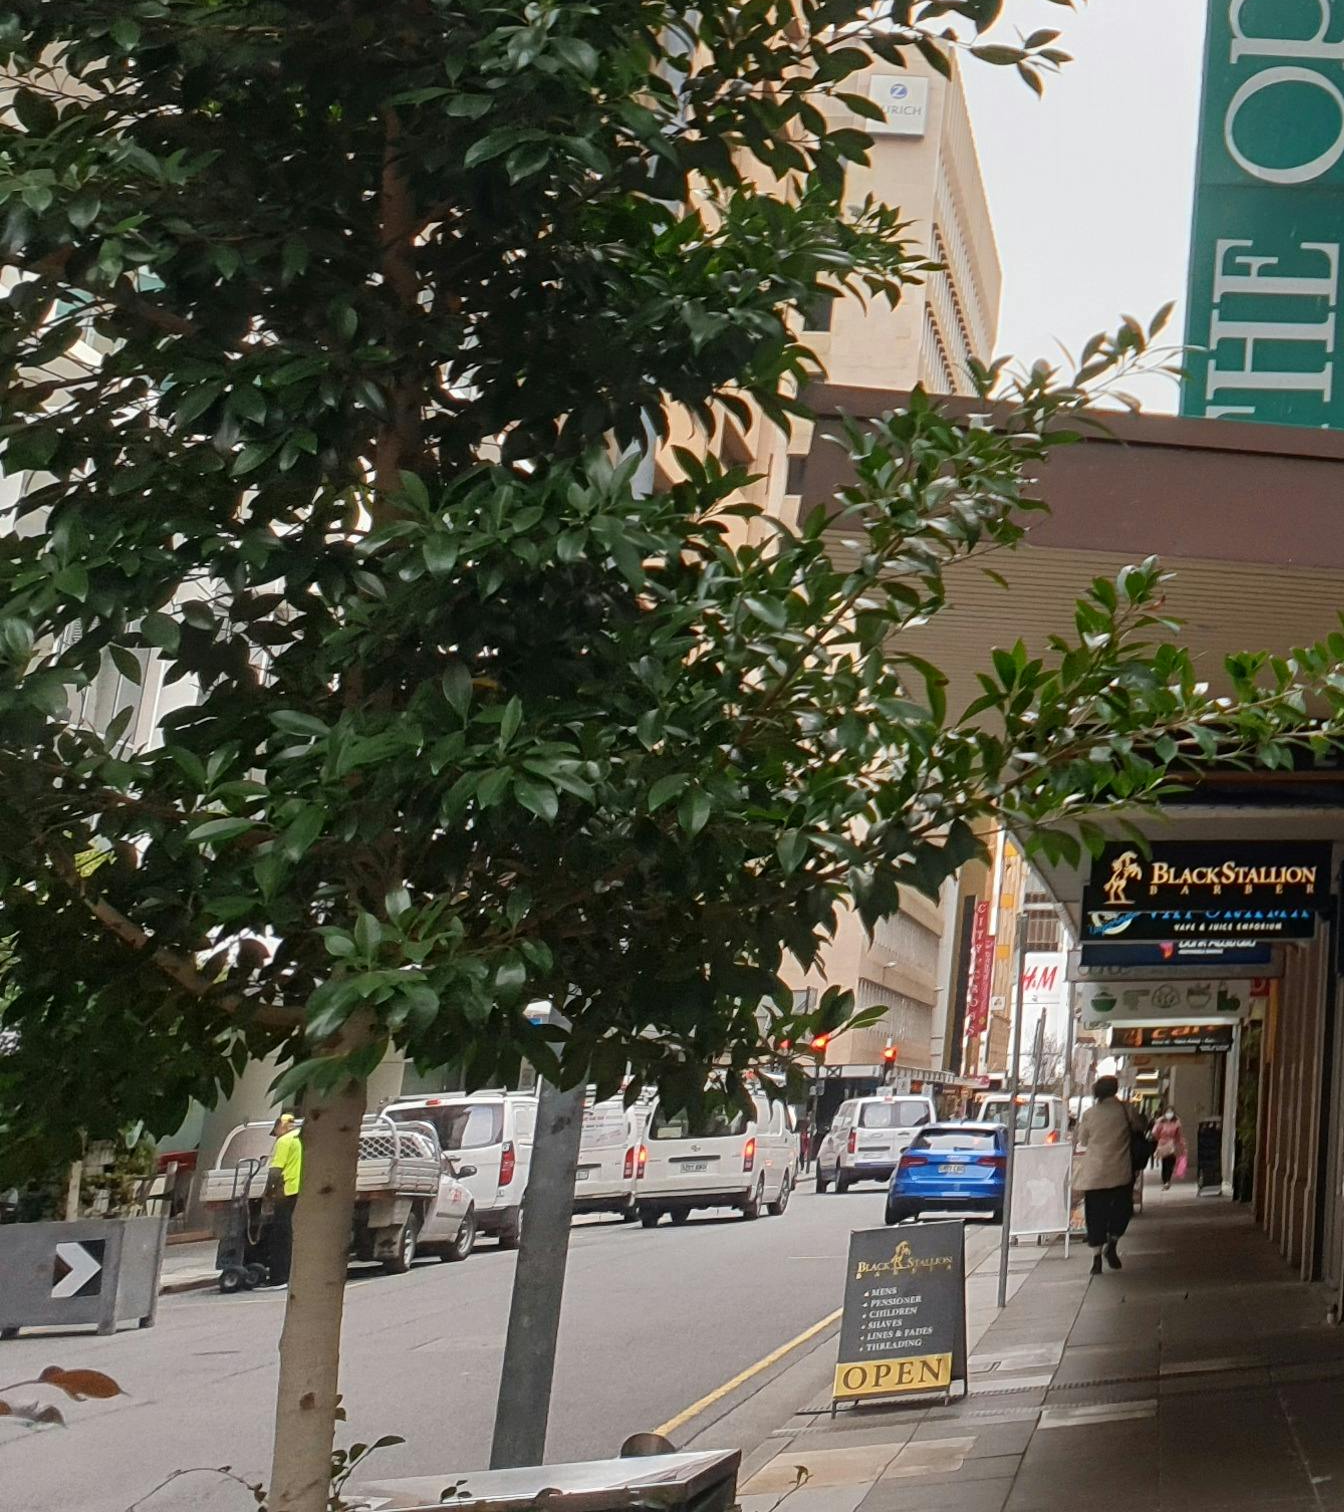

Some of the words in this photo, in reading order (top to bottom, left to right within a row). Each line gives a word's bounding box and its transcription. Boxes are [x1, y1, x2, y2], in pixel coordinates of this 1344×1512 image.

[882, 104, 922, 116] URICH
[1205, 238, 1340, 428] HE
[1150, 884, 1315, 896] BARBER
[871, 1286, 898, 1297] MENS
[870, 1295, 922, 1308] PENSIONER
[869, 1306, 918, 1319] CHILDREN
[868, 1318, 903, 1329] SHAVES
[867, 1330, 894, 1342] LINES
[895, 1329, 902, 1338] &
[904, 1326, 933, 1338] FADES
[866, 1338, 922, 1352] THREADING
[842, 1357, 942, 1390] OPEN
